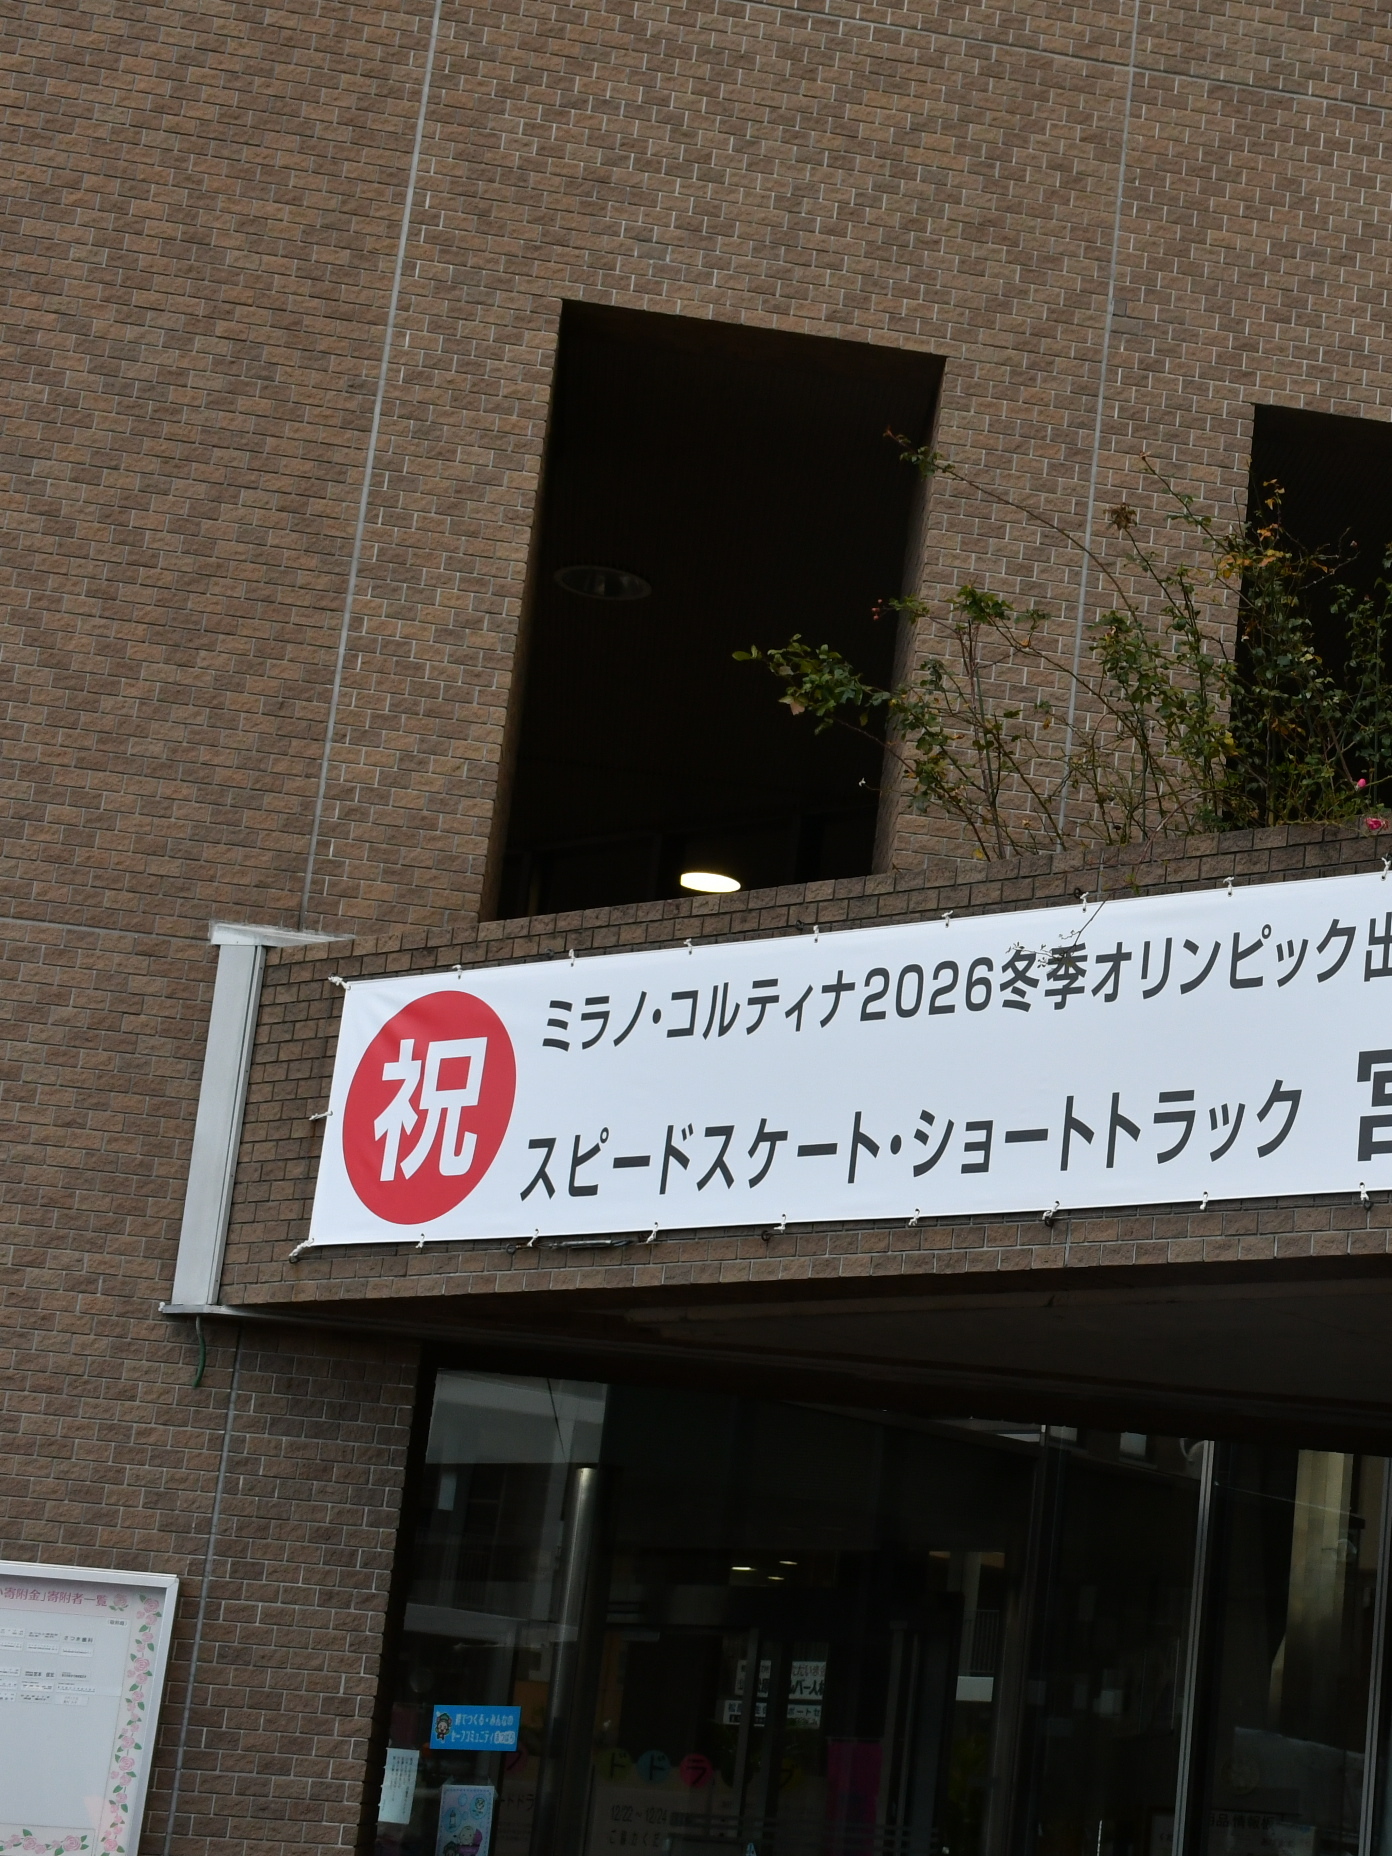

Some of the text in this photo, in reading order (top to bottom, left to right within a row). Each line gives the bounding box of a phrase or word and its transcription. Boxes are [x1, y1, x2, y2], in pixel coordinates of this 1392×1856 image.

[371, 1036, 489, 1184] 祝
[519, 1079, 1303, 1203] スピードスケート・ショートトラック
